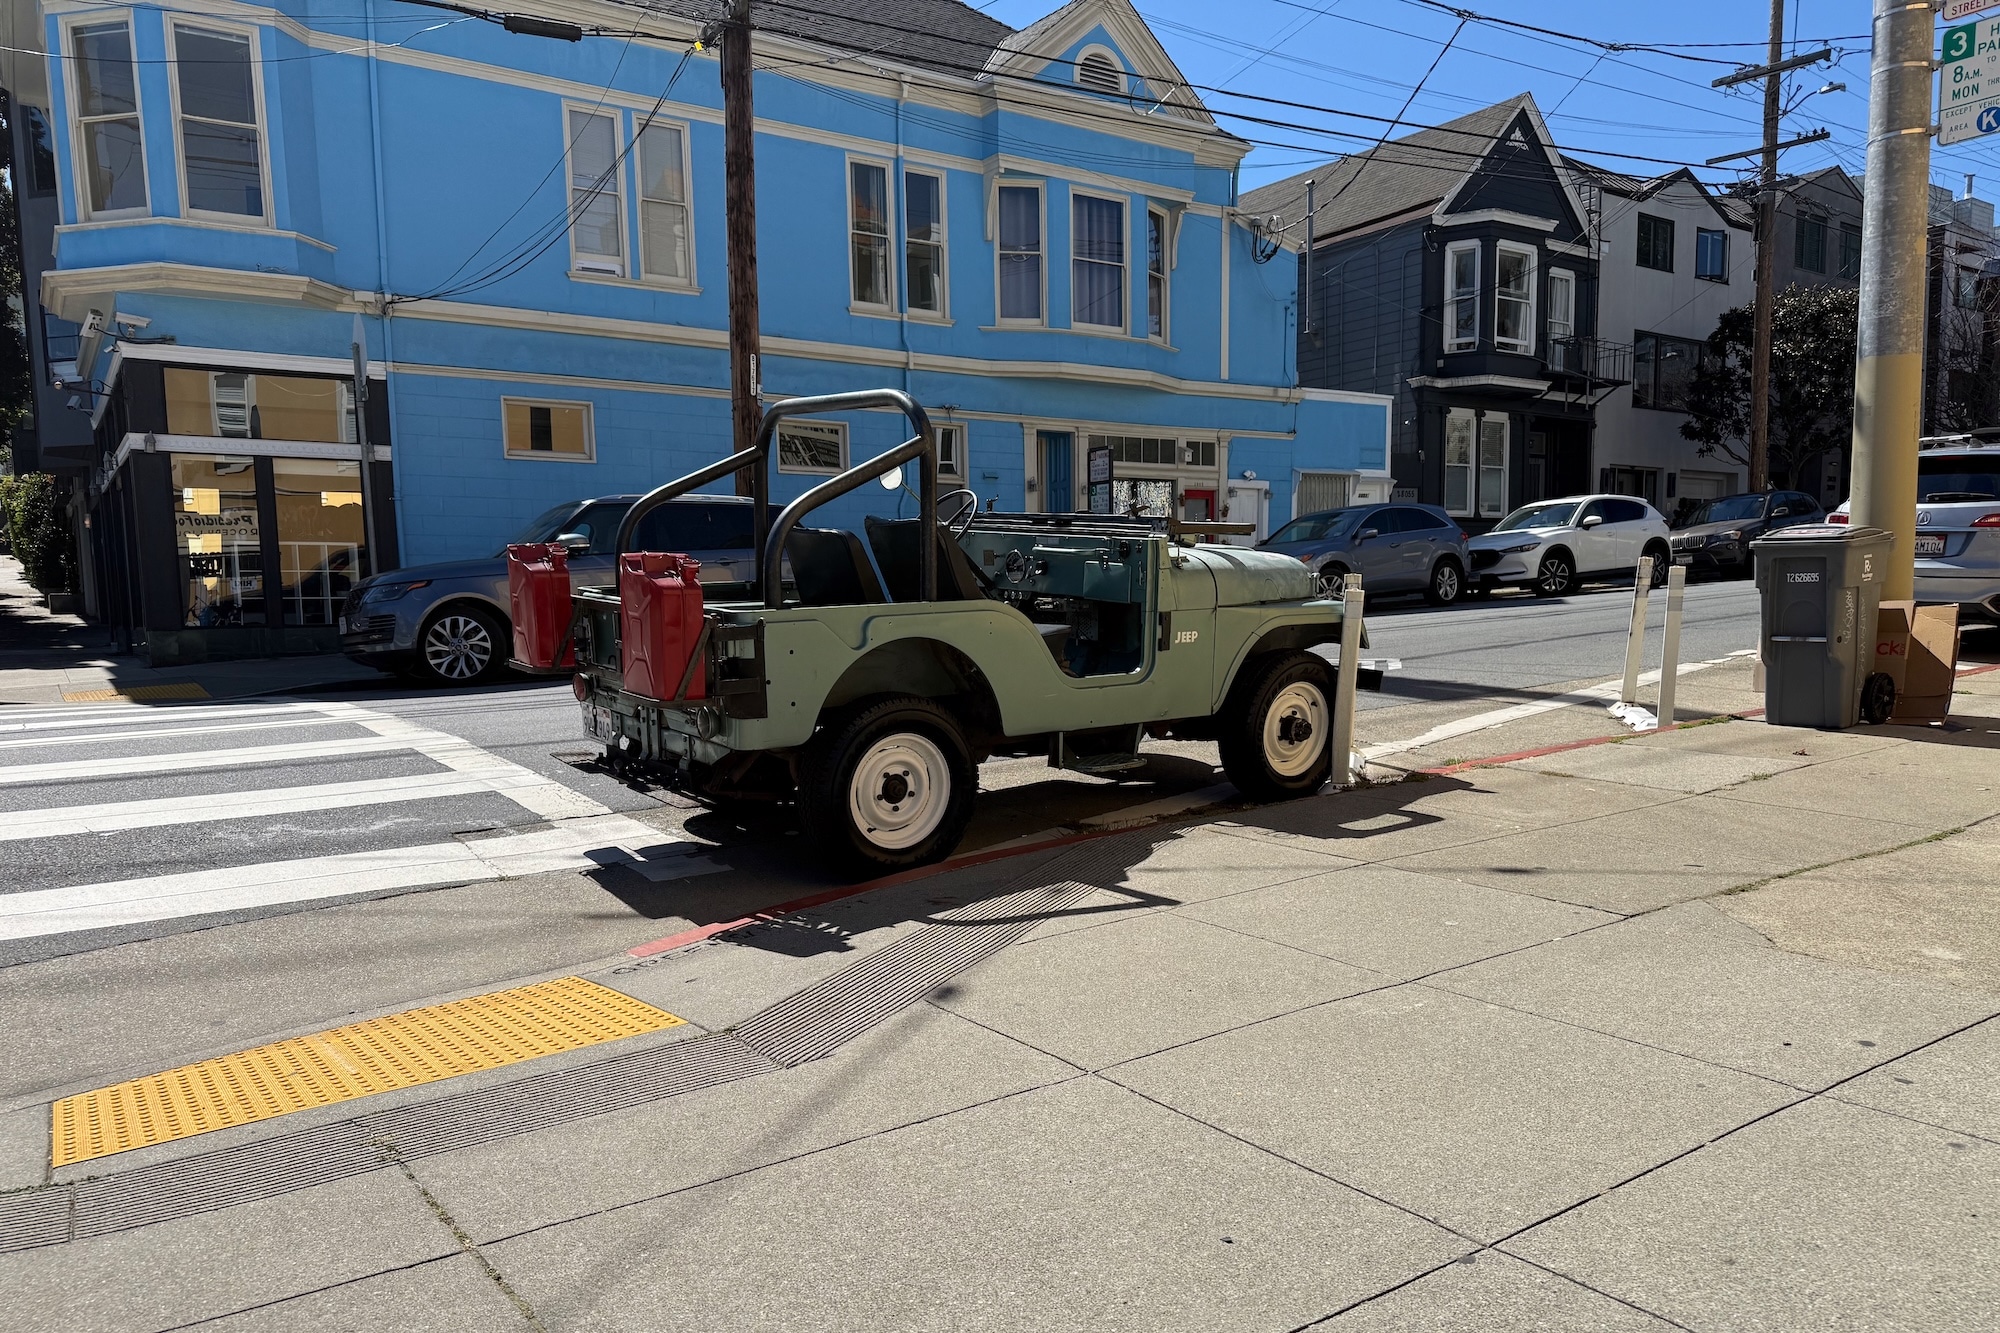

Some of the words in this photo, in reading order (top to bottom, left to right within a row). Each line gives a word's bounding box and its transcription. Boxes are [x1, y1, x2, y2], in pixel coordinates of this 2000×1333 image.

[1950, 31, 1968, 57] 3
[1977, 37, 2000, 55] PA
[1987, 55, 1997, 64] TO
[1952, 82, 1980, 101] MON
[1946, 106, 1972, 118] EXCEPT
[1981, 109, 1998, 131] K
[1949, 122, 1969, 133] AREA
[1174, 630, 1199, 644] JEEP
